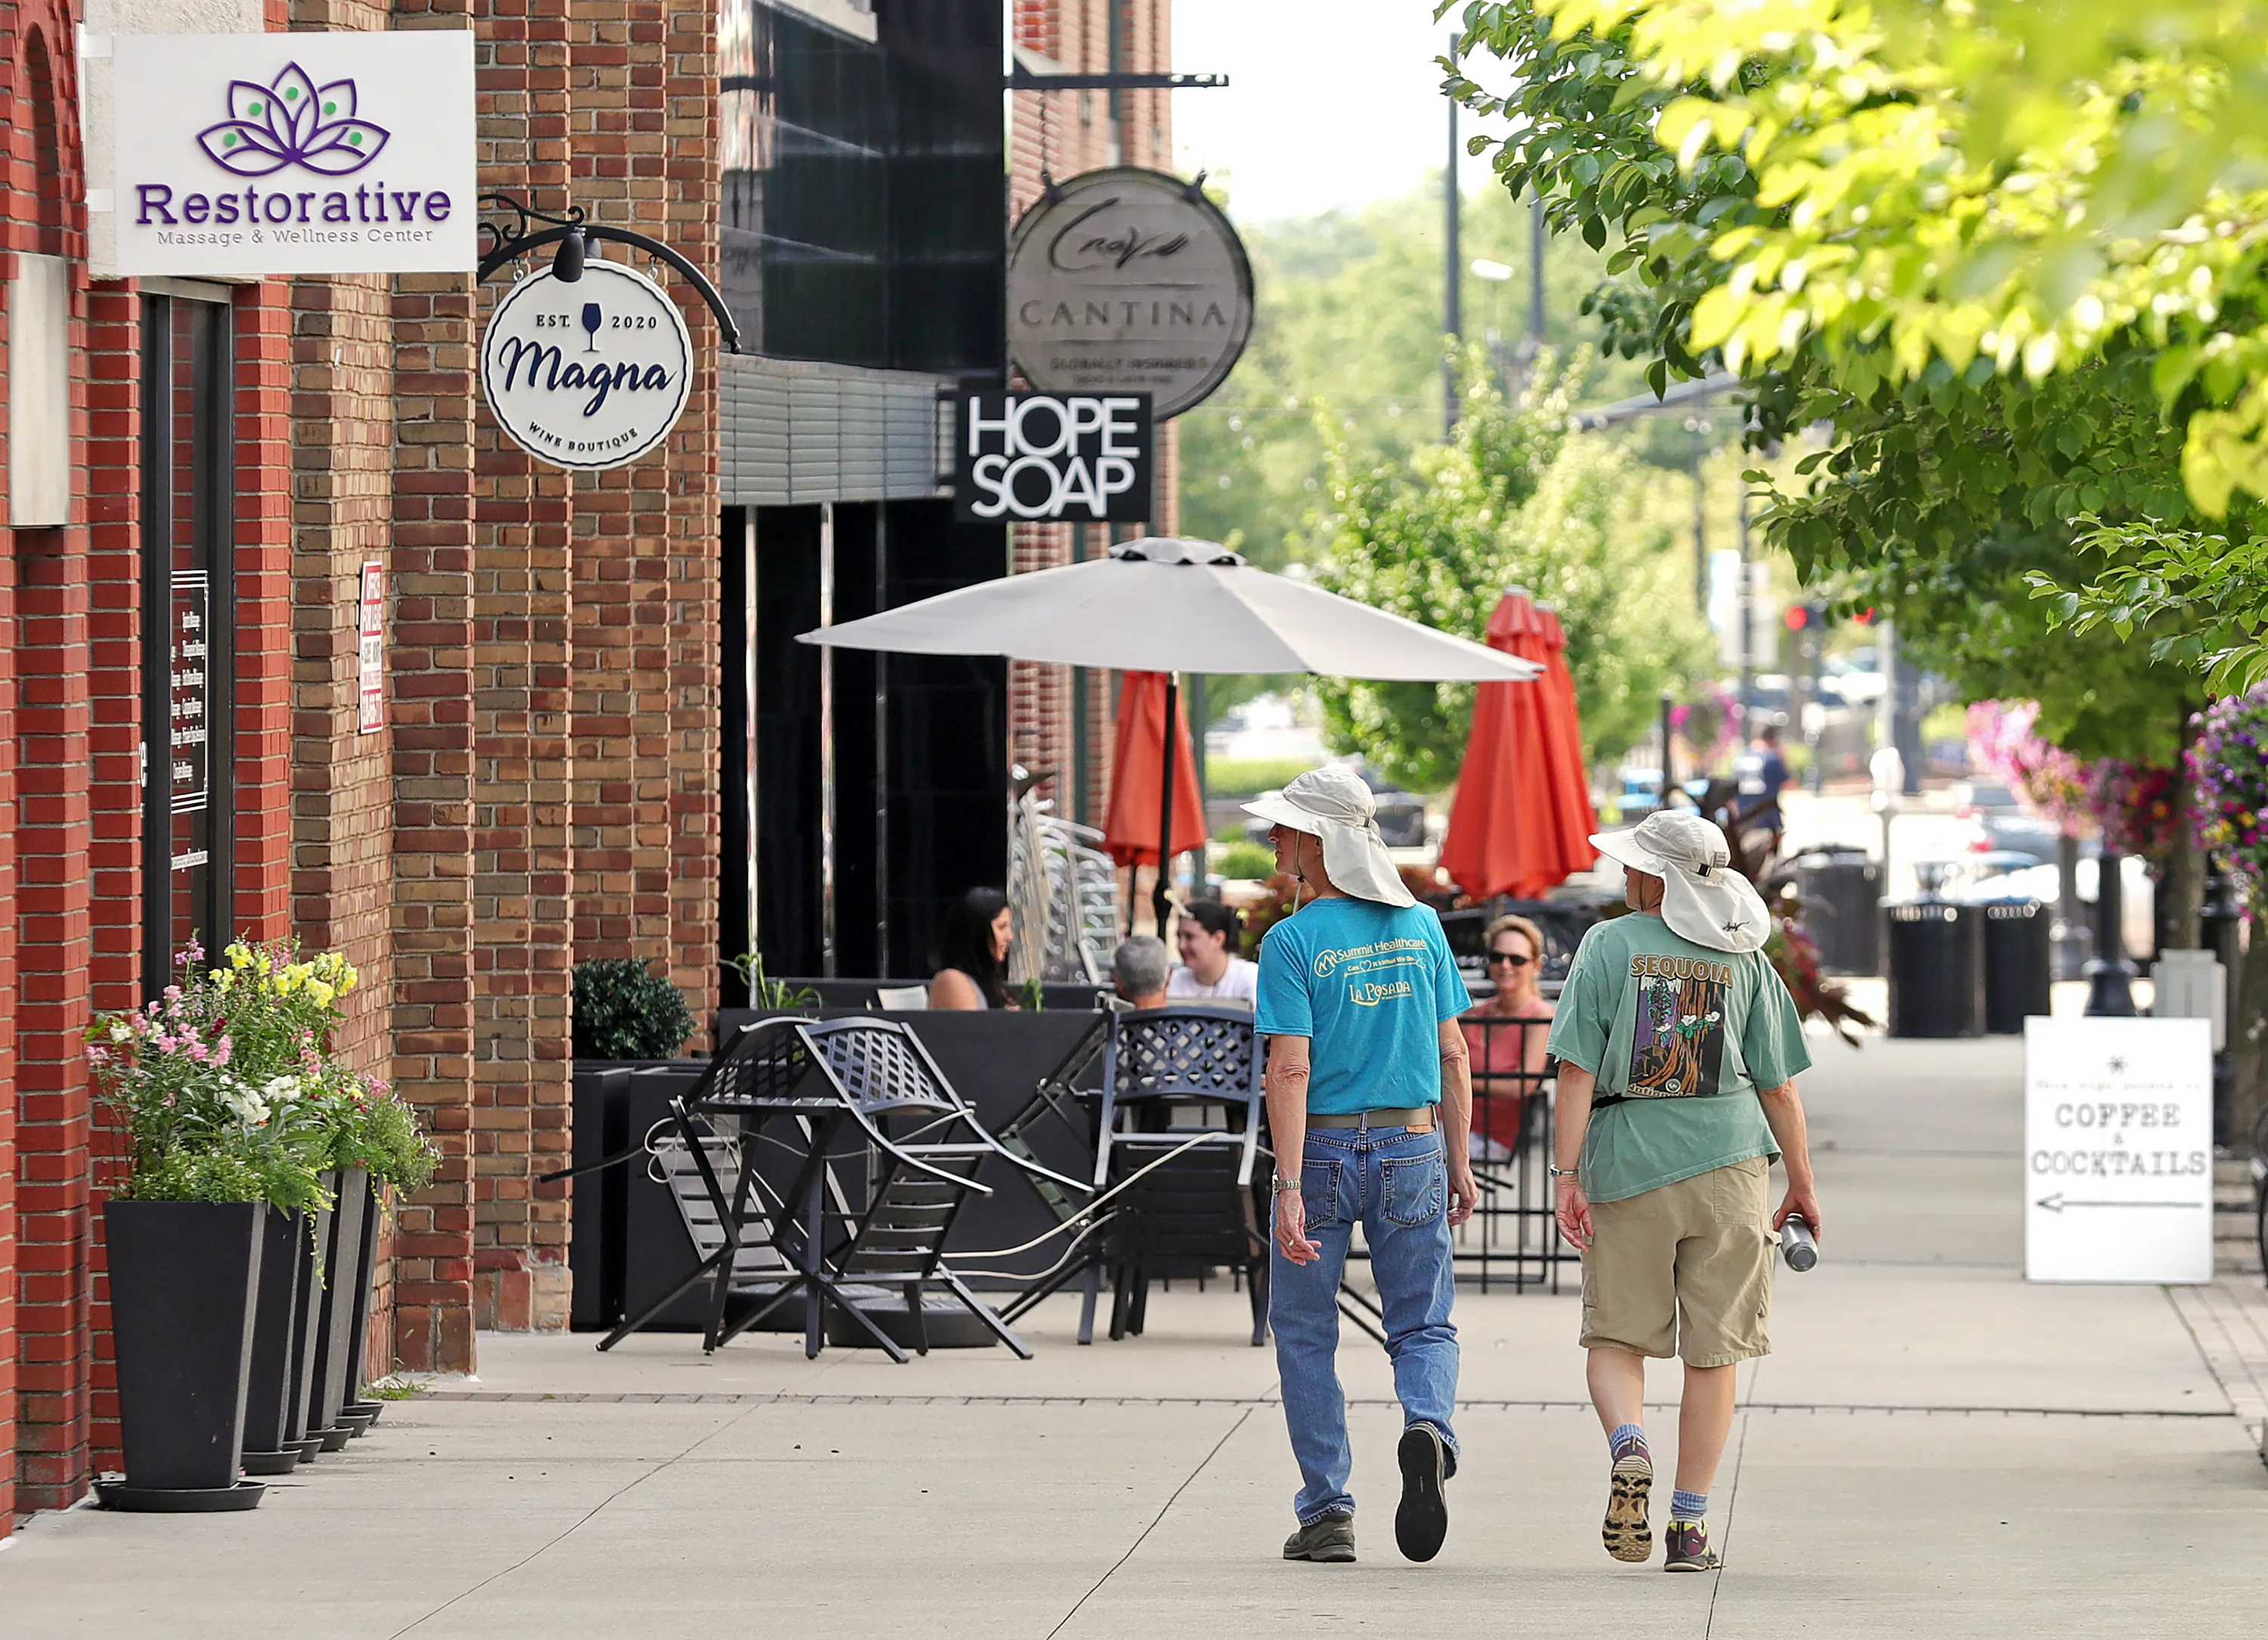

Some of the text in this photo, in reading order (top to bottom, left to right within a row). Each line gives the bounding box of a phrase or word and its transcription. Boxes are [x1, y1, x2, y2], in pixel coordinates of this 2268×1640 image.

[135, 181, 451, 224] Restorative
[157, 228, 433, 247] Massage & Wellness Center
[536, 315, 657, 329] EST. 2020
[1020, 299, 1226, 326] CANTINA
[499, 336, 677, 417] Magna
[529, 421, 638, 451] WINE BOUTIQUE
[969, 396, 1140, 458] HOPE
[971, 454, 1136, 519] SOAP
[1337, 938, 1427, 960] Summit Healthcare
[1630, 954, 1734, 988] SEQUOIA
[2054, 1103, 2181, 1128] COFFEE
[2031, 1149, 2208, 1177] COCKTAILS
